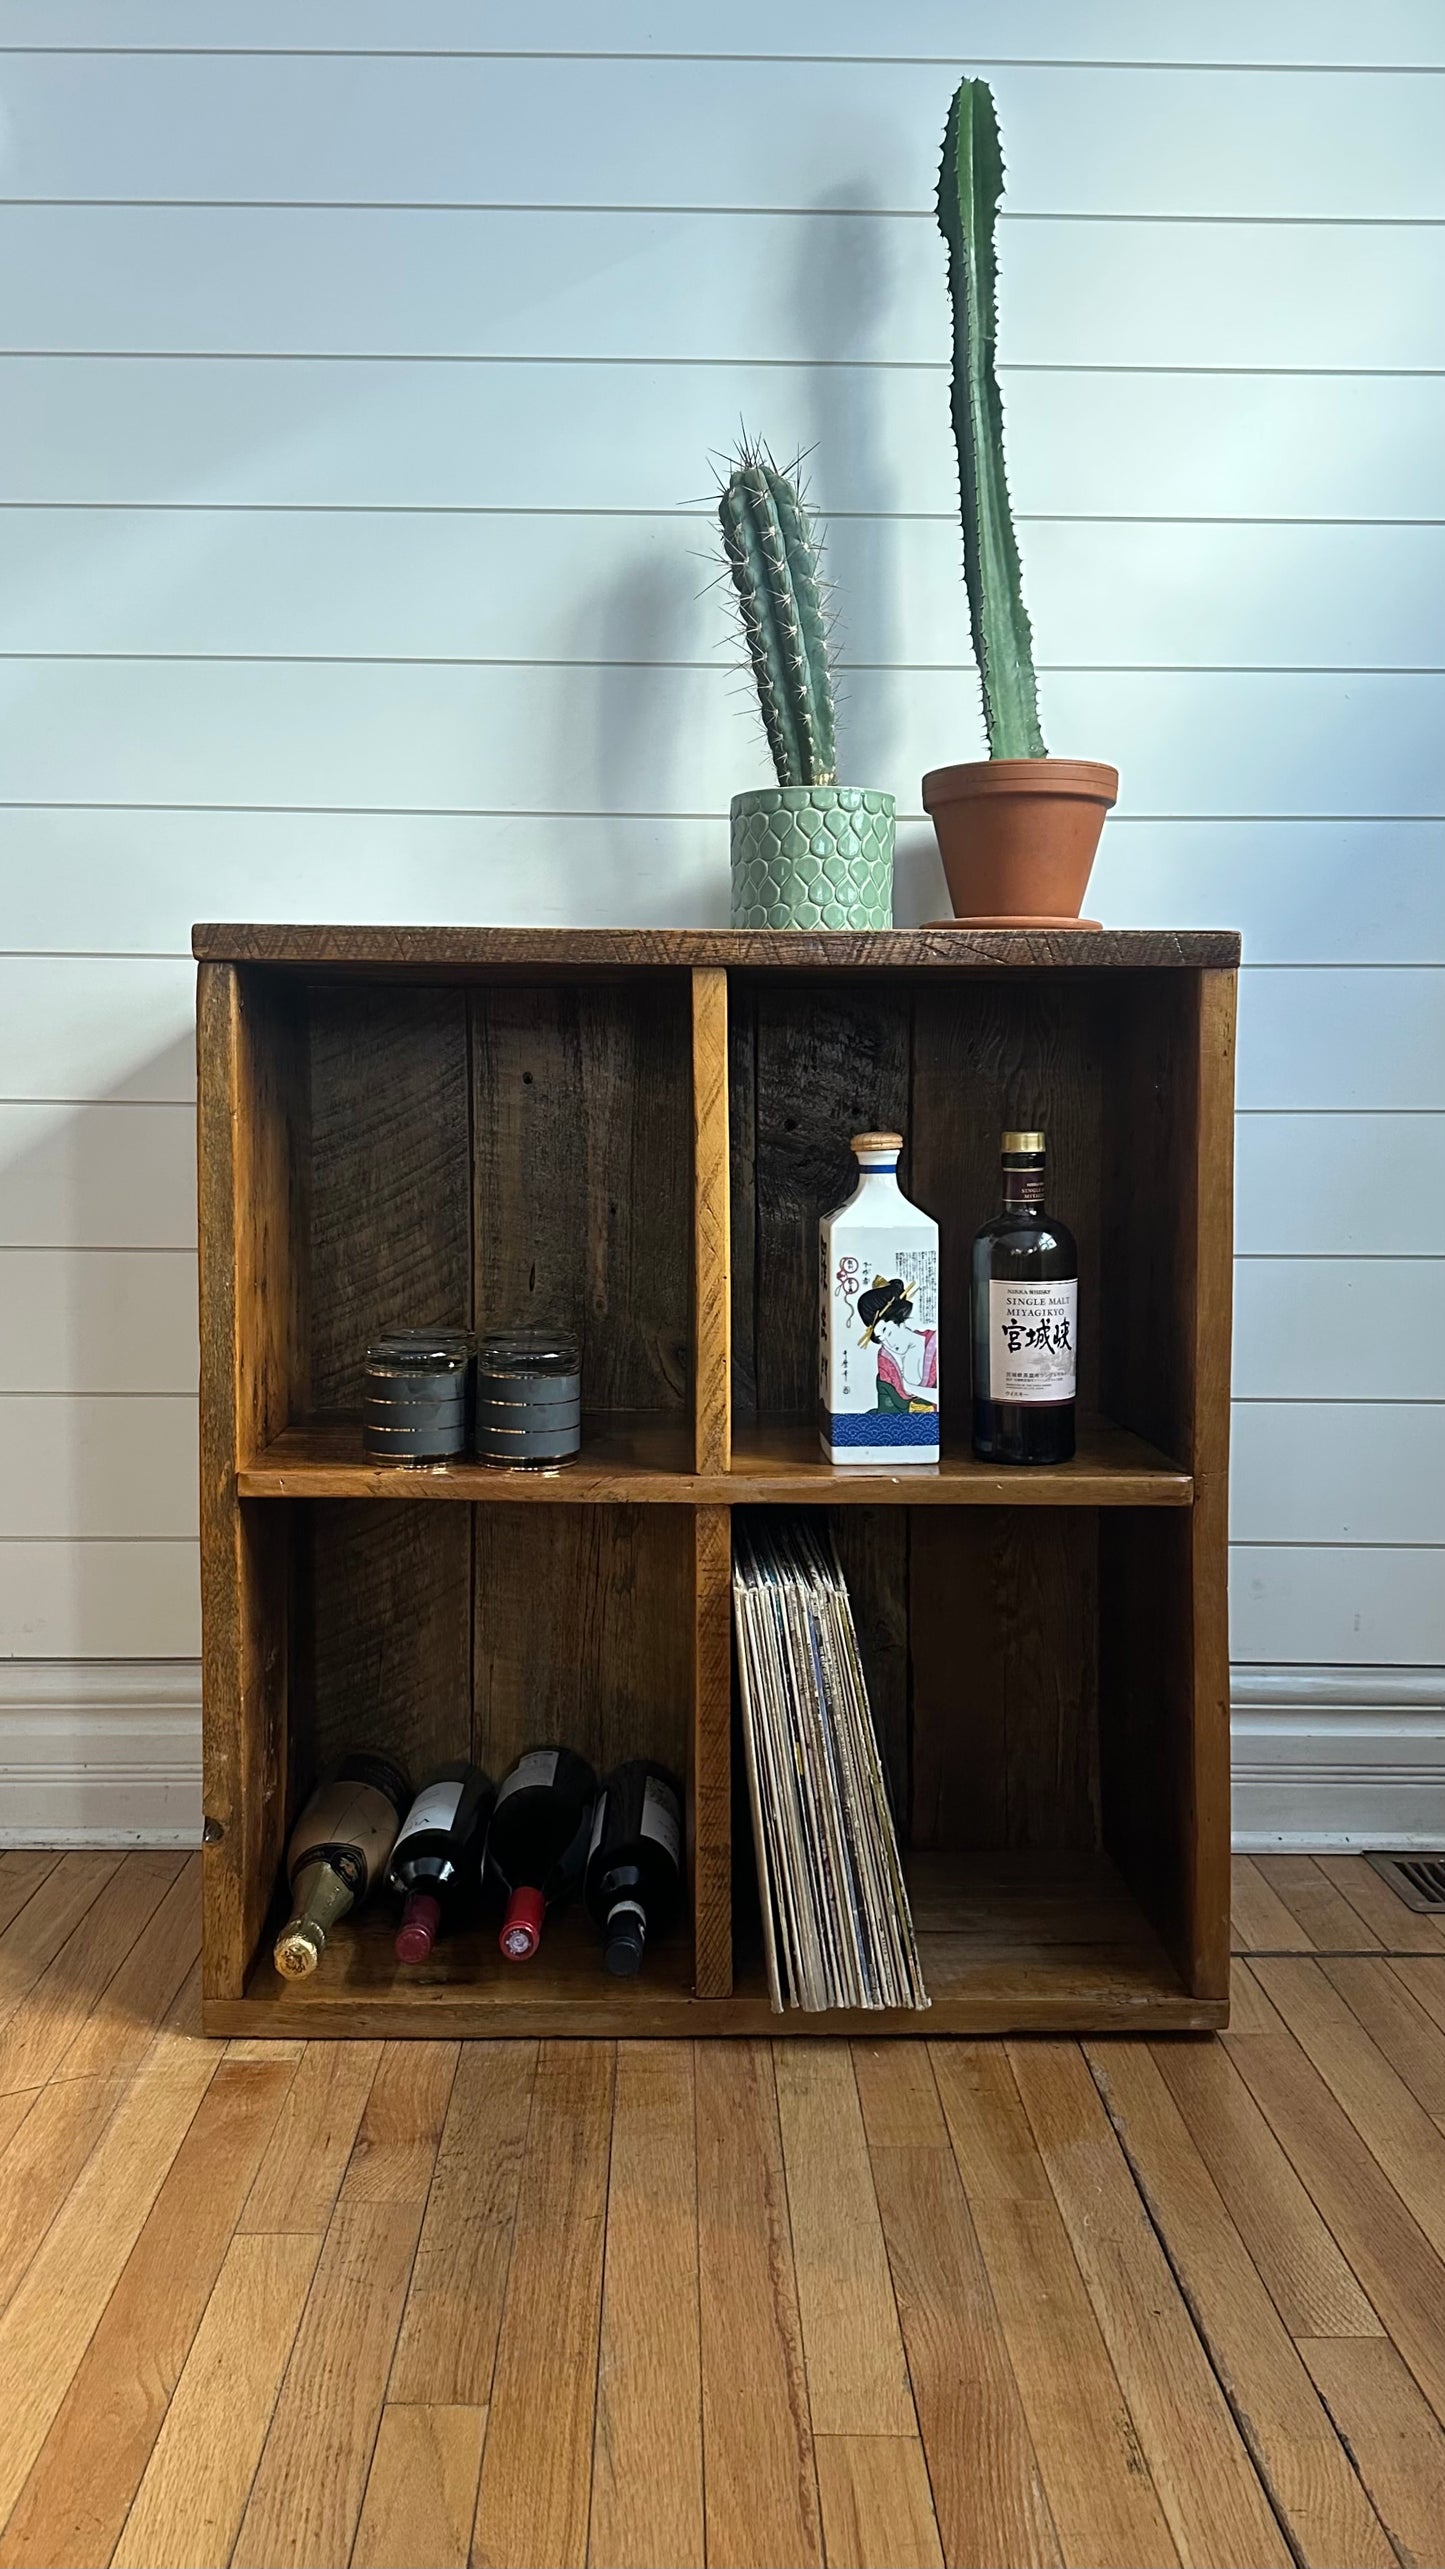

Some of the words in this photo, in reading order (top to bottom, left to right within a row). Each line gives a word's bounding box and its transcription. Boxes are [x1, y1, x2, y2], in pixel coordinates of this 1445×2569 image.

[1006, 1297, 1046, 1306] SINGLE
[1048, 1296, 1070, 1305] MALT
[1006, 1308, 1065, 1317] MIYAGIKYO
[1001, 1317, 1072, 1355] 宮城峡
